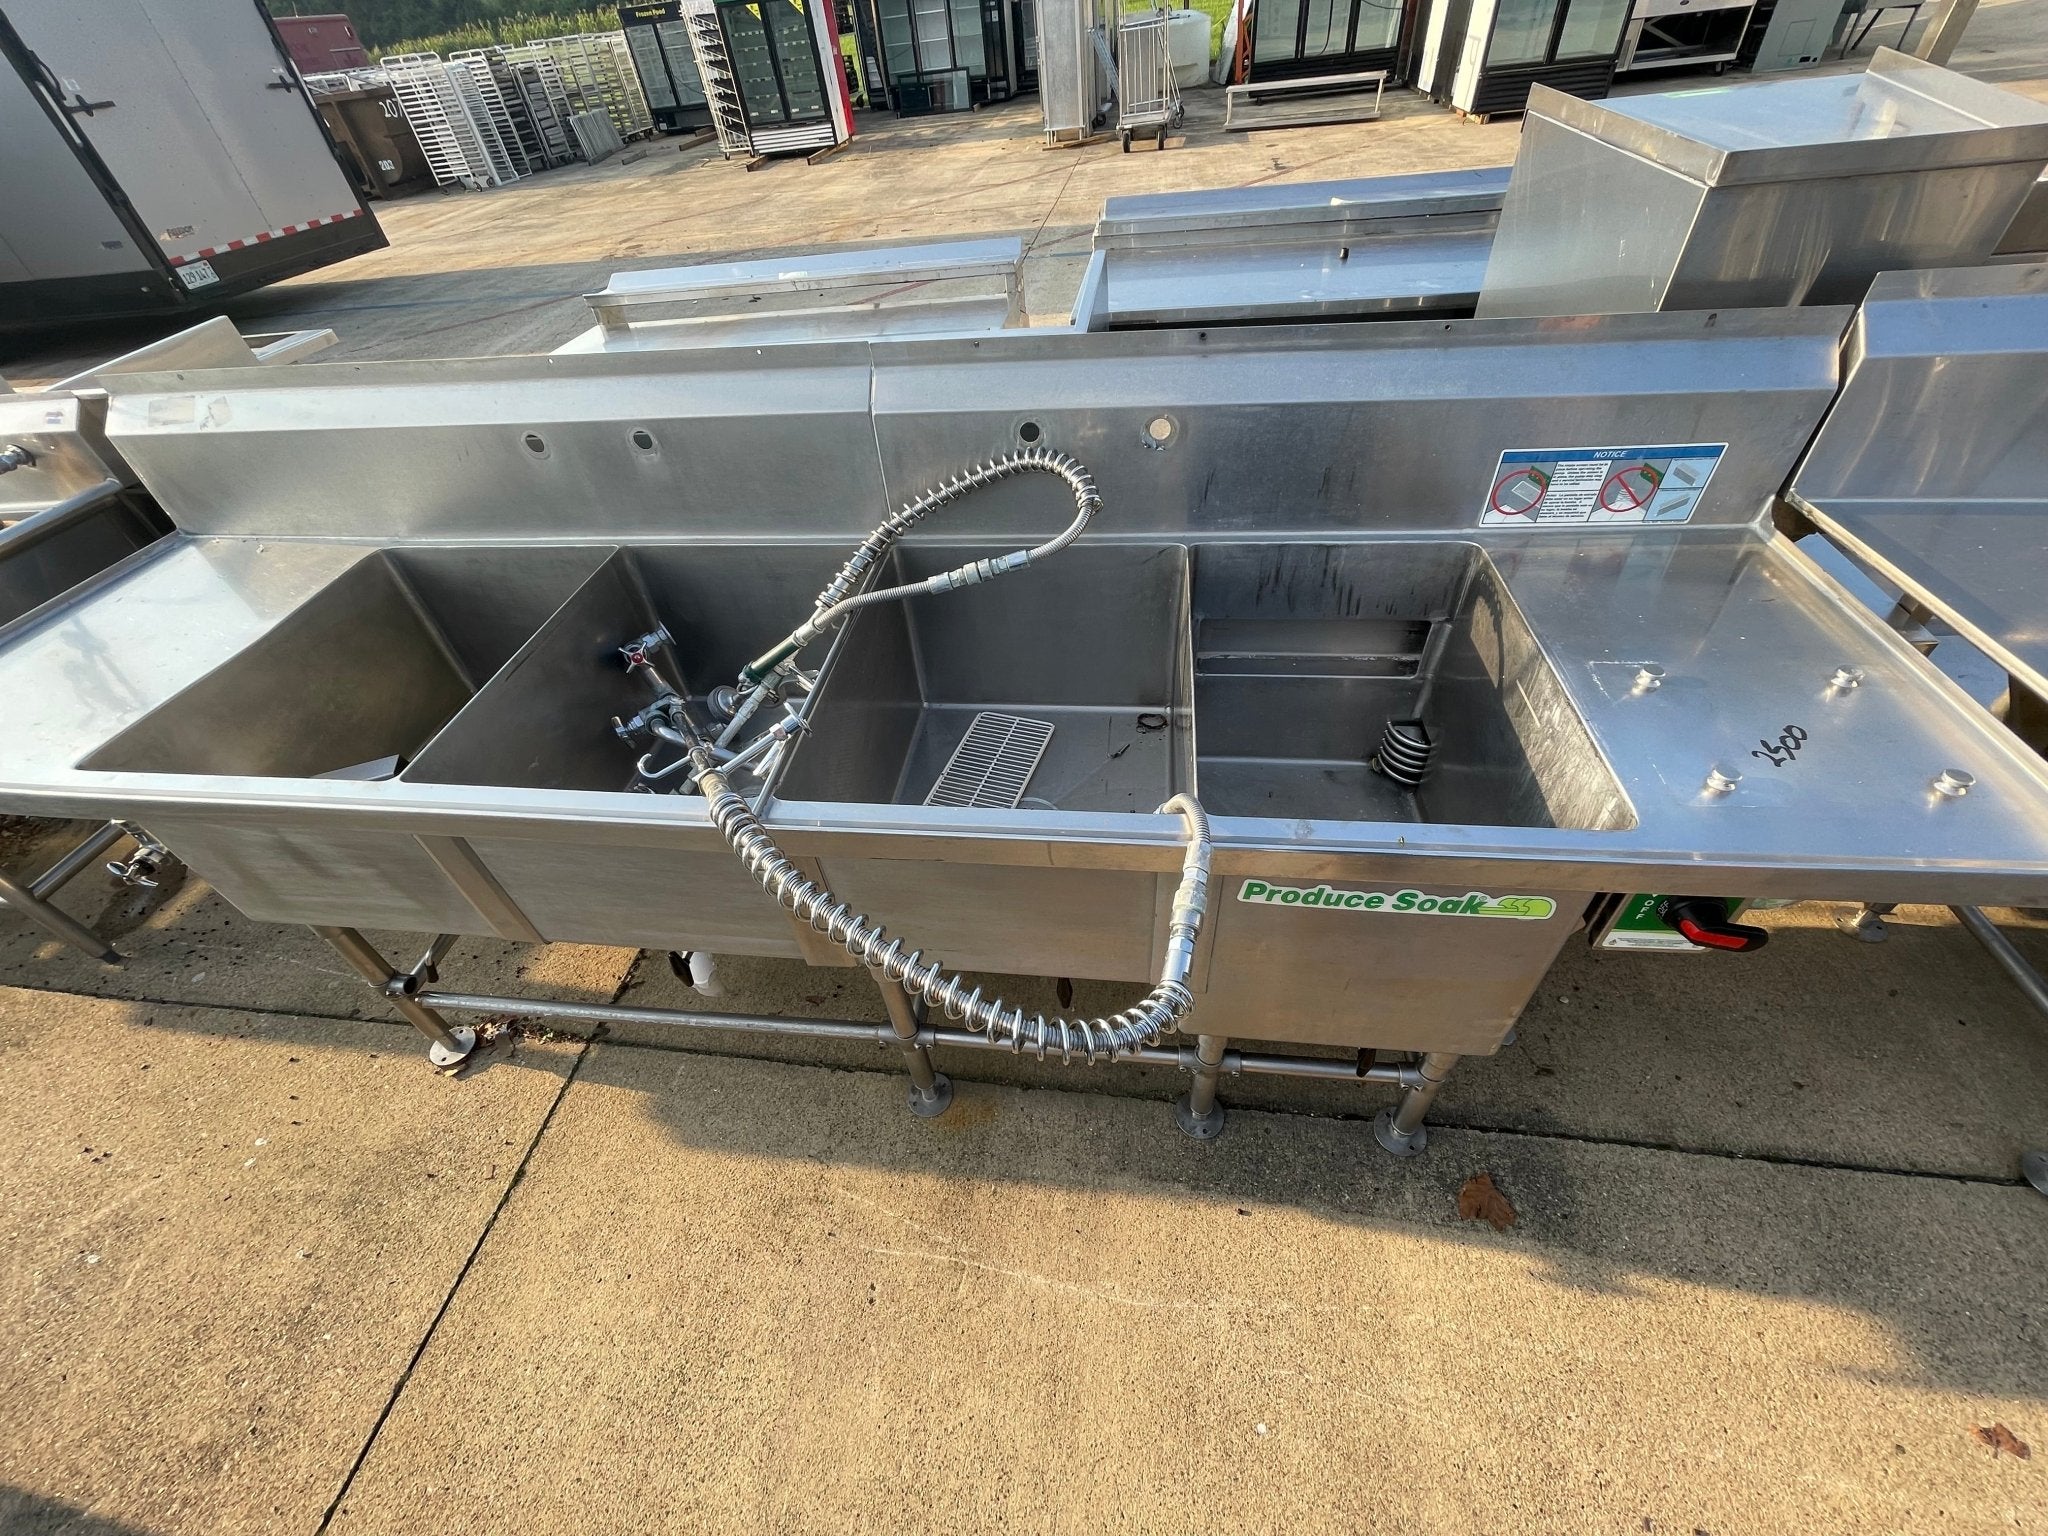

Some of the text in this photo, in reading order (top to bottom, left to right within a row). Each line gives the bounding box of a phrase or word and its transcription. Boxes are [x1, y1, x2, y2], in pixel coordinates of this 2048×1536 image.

[378, 160, 395, 170] 203
[1593, 450, 1628, 459] NOTICE
[1751, 724, 1808, 768] 2500
[1242, 882, 1385, 910] Produce
[1635, 900, 1654, 919] OFF
